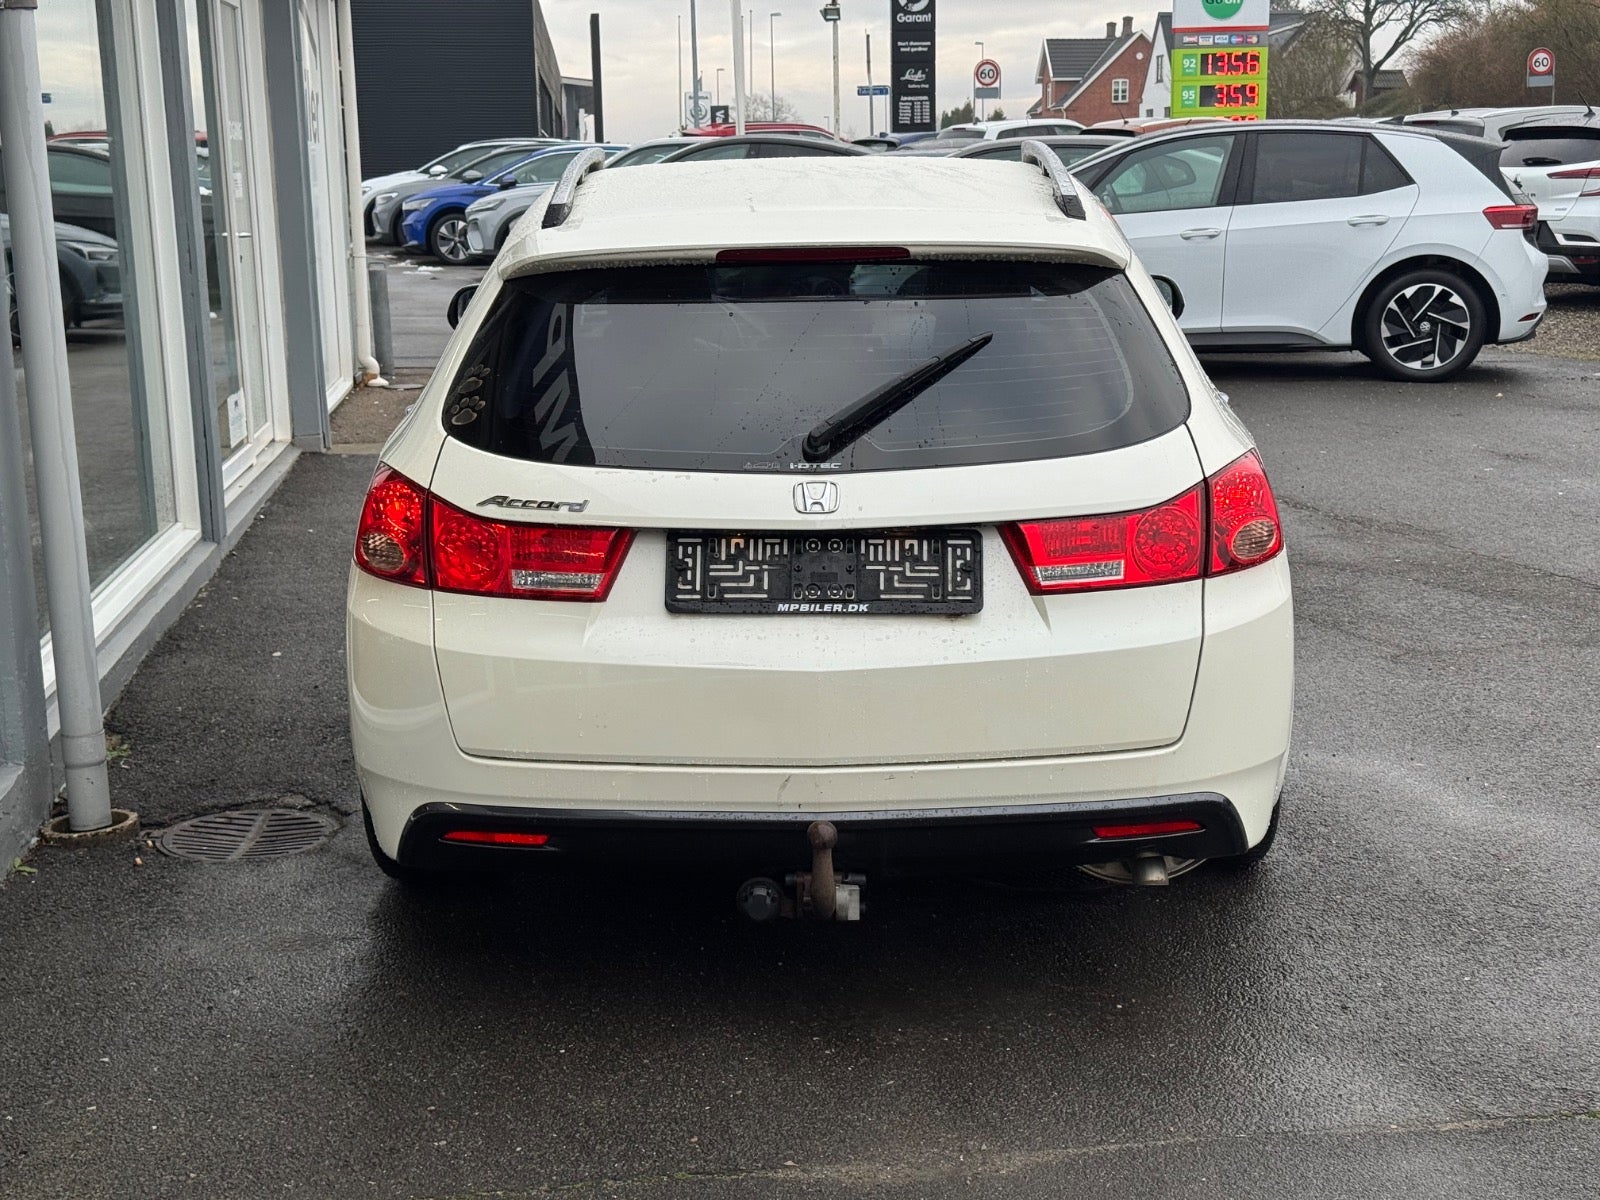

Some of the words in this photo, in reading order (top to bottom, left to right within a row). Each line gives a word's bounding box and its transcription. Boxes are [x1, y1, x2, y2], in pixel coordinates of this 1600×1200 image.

[897, 13, 931, 23] Garant
[1183, 59, 1196, 68] 92
[1534, 57, 1549, 67] 60
[980, 69, 995, 79] 60
[1182, 91, 1195, 100] 95
[476, 495, 590, 512] Accord
[777, 603, 869, 613] MPBILER.DK
